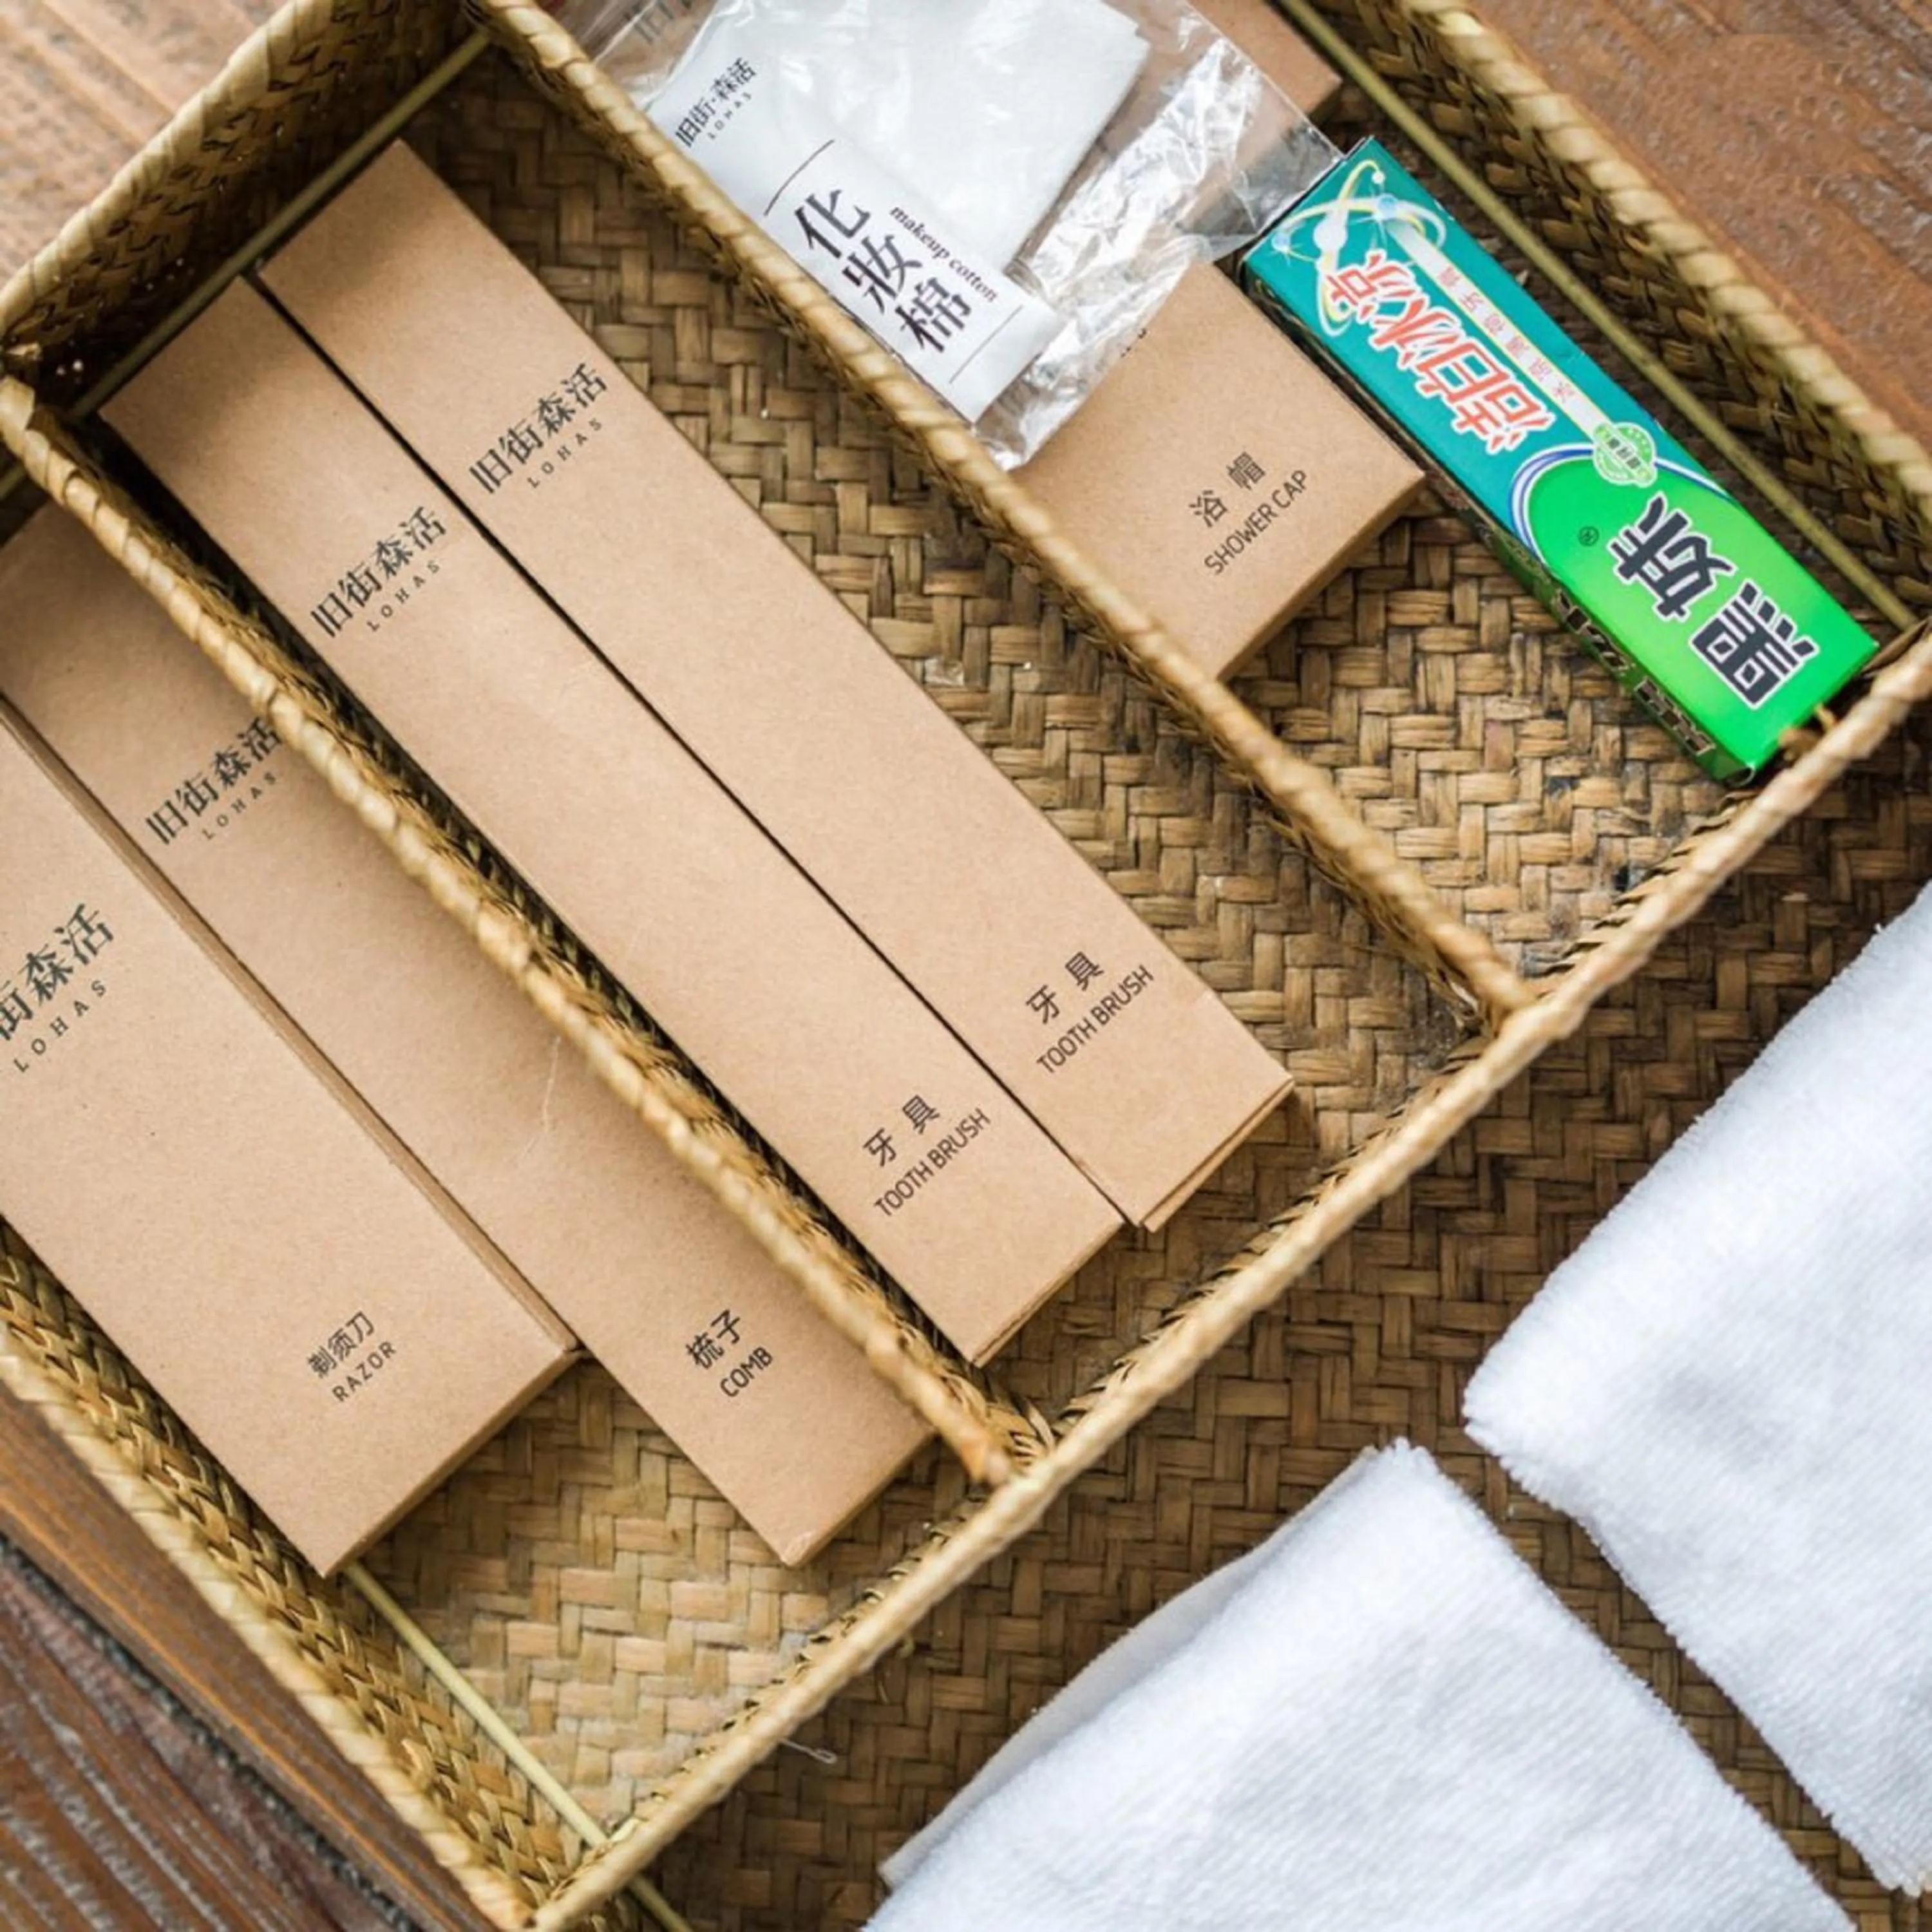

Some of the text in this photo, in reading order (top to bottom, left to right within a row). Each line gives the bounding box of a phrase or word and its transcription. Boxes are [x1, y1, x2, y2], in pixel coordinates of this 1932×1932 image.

[706, 91, 752, 140] LOHAS
[889, 205, 998, 302] makeup cotton
[1325, 248, 1556, 455] 洁白冰凉
[469, 363, 607, 493] 旧街森活
[527, 421, 603, 489] LOHAS
[1189, 451, 1265, 528] 浴帽
[1204, 469, 1308, 575] SHOWER CAP
[310, 507, 446, 638] 旧街森活
[366, 560, 440, 632] LOHAS
[1608, 491, 1819, 709] 黑妹
[146, 717, 283, 845] 旧街森活
[202, 772, 277, 840] LOHAS
[13, 980, 107, 1073] LOHAS
[1026, 951, 1104, 1025] 牙具
[1036, 964, 1154, 1074] TOOTH BRUSH
[863, 1094, 940, 1167] 牙具
[874, 1108, 991, 1217] TOOTH BRUSH
[307, 1311, 375, 1378] 剃须刀
[332, 1341, 397, 1402] RAZOR
[685, 1309, 744, 1371] 梳子
[721, 1346, 773, 1398] COMB
